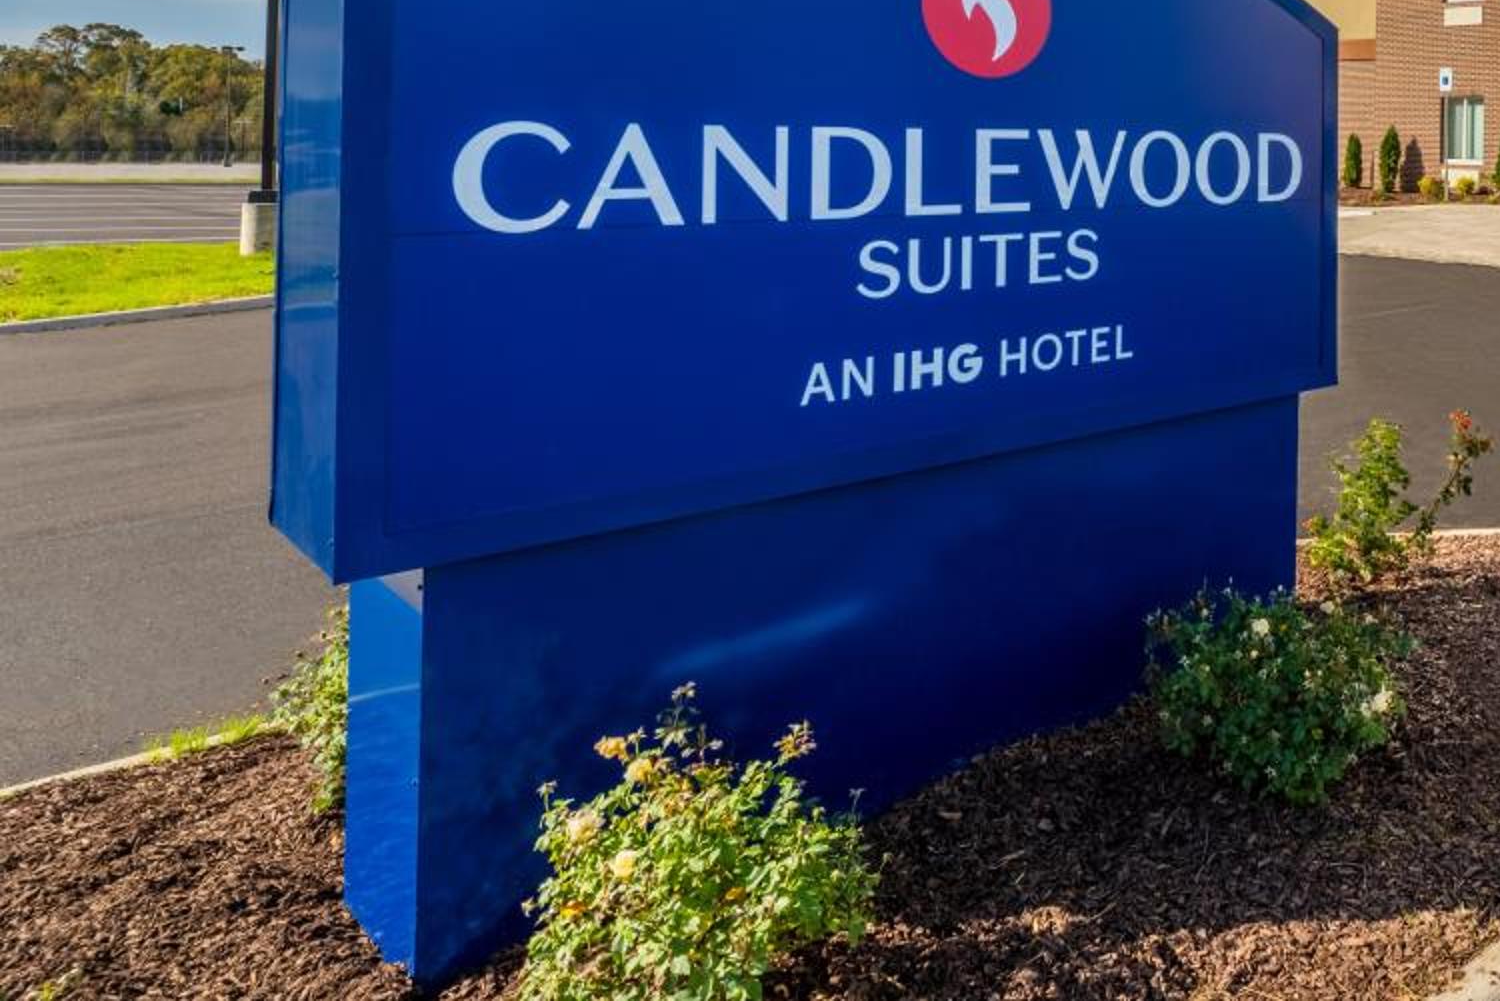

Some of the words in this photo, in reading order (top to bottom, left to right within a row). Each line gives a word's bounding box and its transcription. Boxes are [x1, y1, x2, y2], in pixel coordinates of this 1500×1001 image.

[452, 120, 1304, 234] CANDLEWOOD
[856, 229, 1100, 299] SUITES
[801, 356, 875, 407] AN
[893, 343, 984, 392] IHG
[1000, 326, 1134, 377] HOTEL
